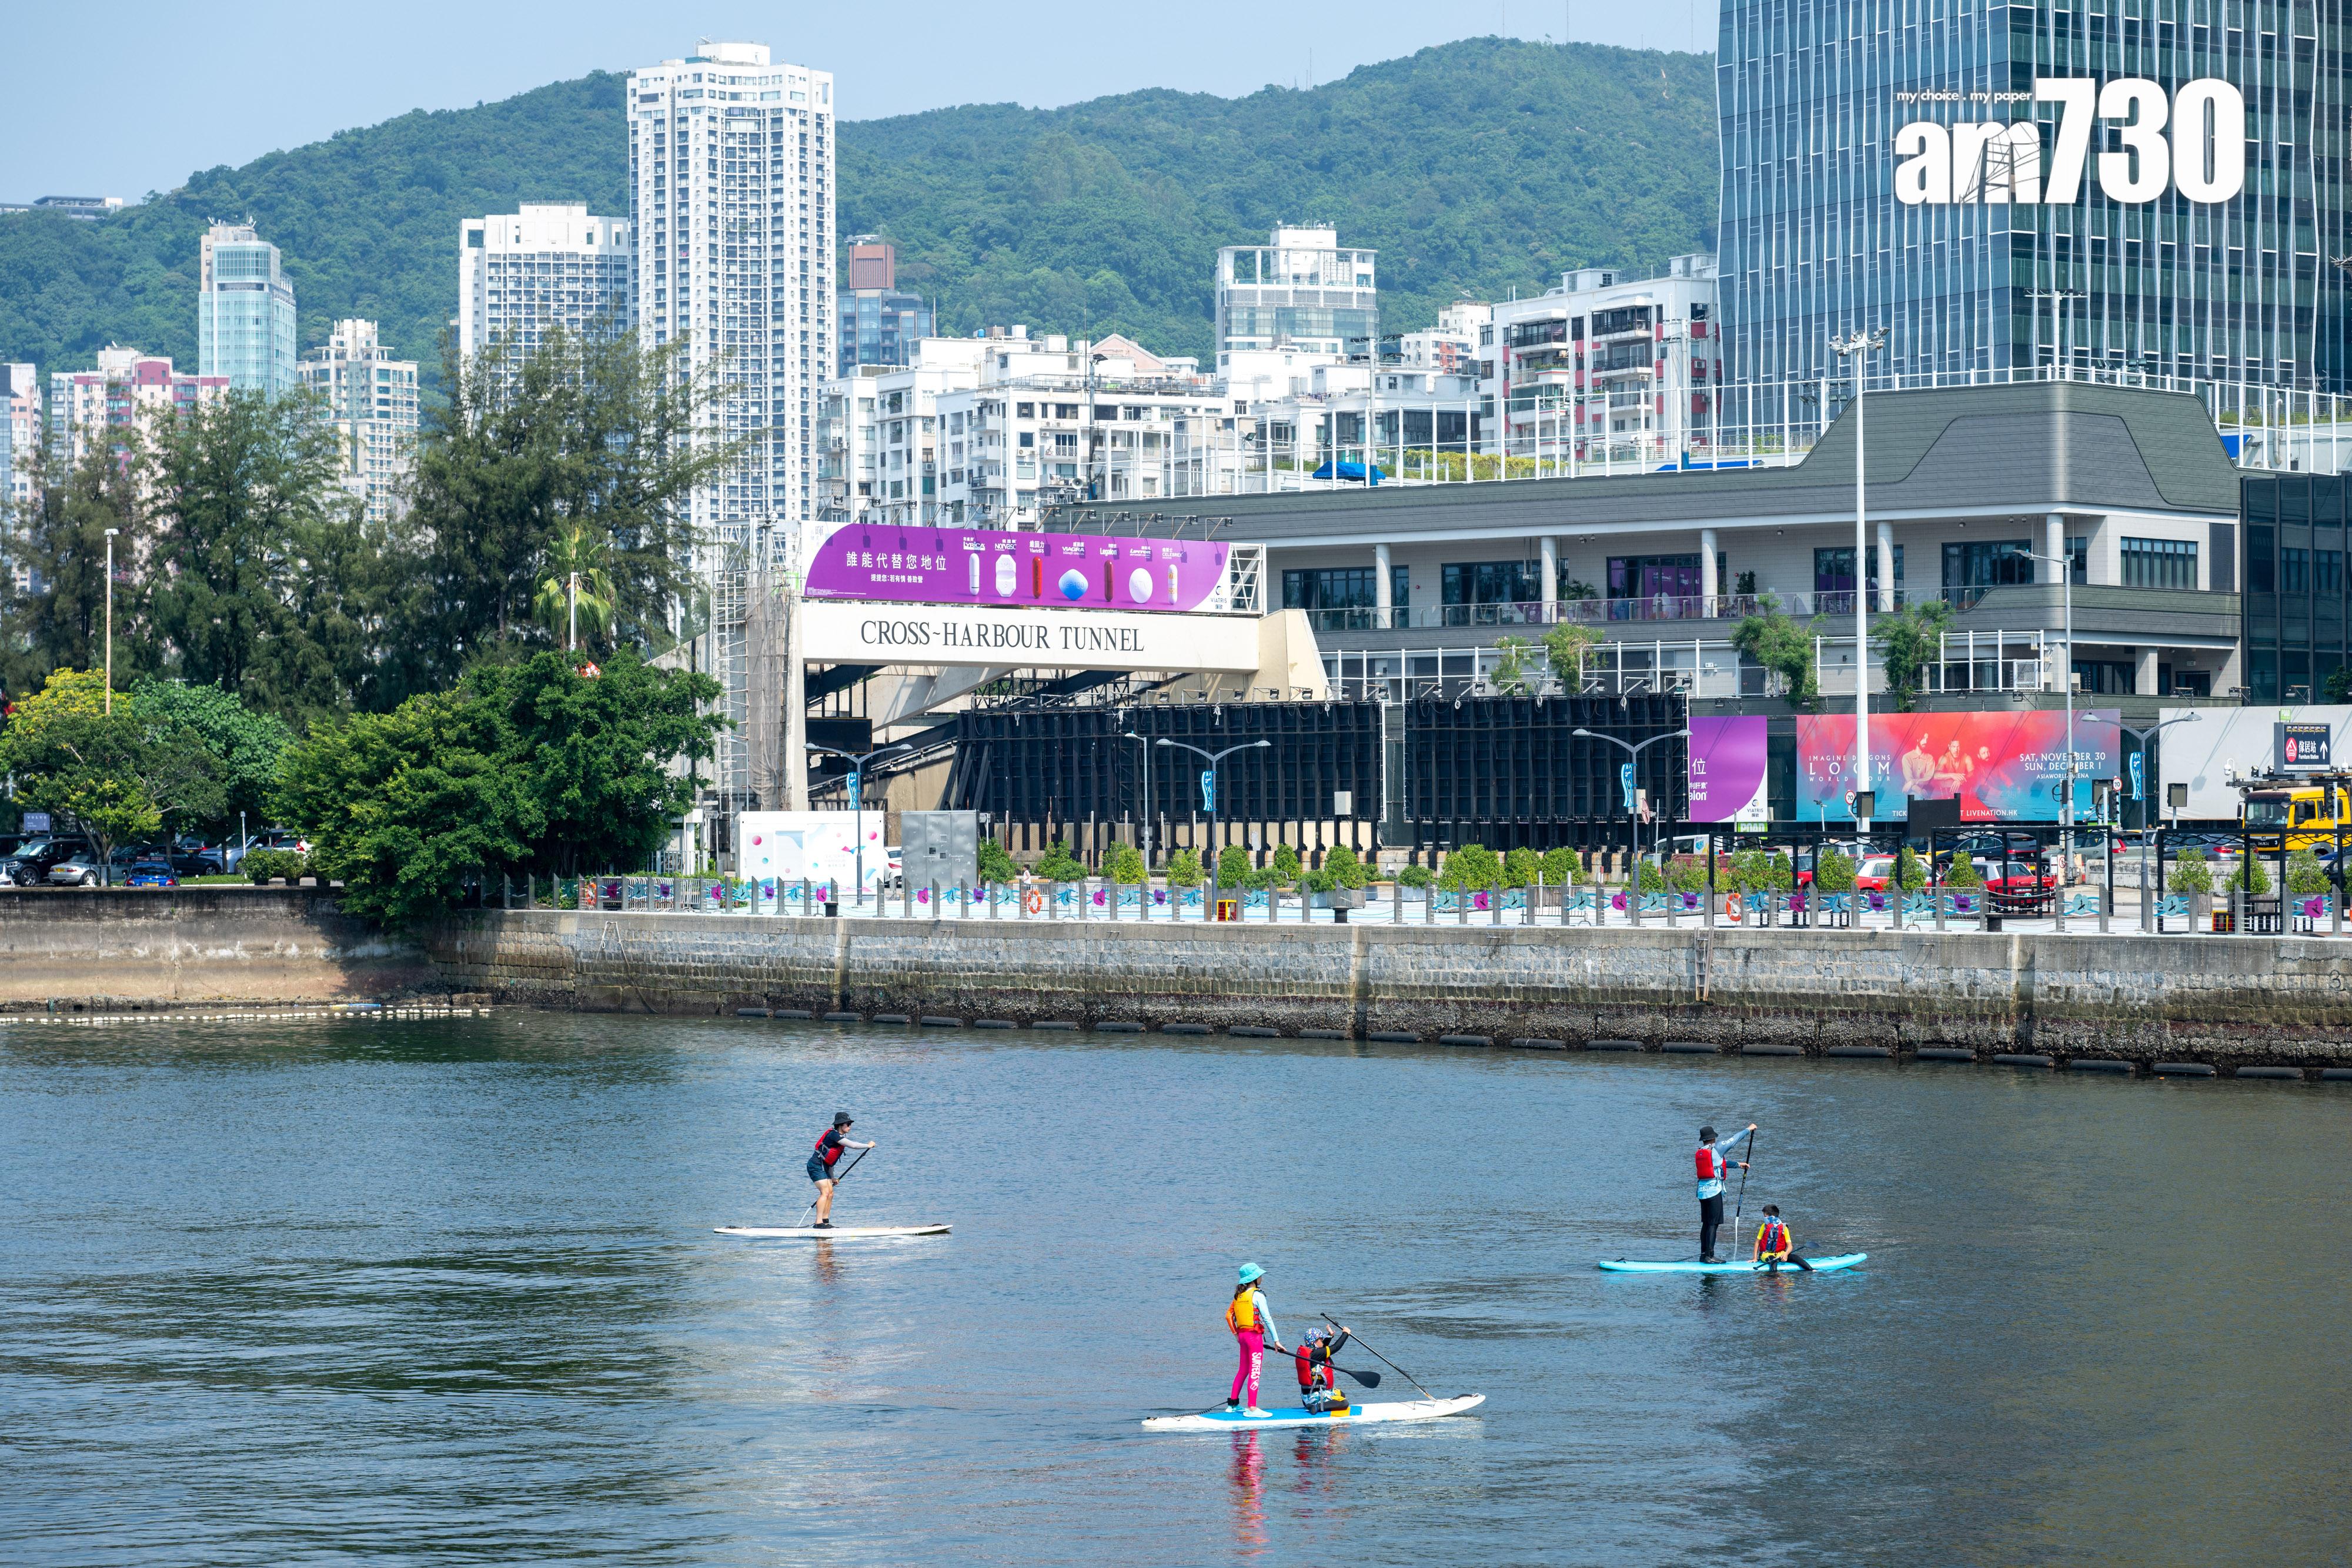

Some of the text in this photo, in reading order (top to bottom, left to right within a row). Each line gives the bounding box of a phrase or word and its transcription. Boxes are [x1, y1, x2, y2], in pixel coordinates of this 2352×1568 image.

[847, 551, 946, 570] 誰能代替您地位
[1060, 627, 1144, 652] TUNNEL
[2299, 741, 2316, 753] 傢居站
[2020, 752, 2106, 762] SAT, NOVEBER 30
[1692, 758, 1706, 775] 位
[2025, 763, 2046, 771] SUN,
[1251, 1352, 1262, 1379] SURFERS
